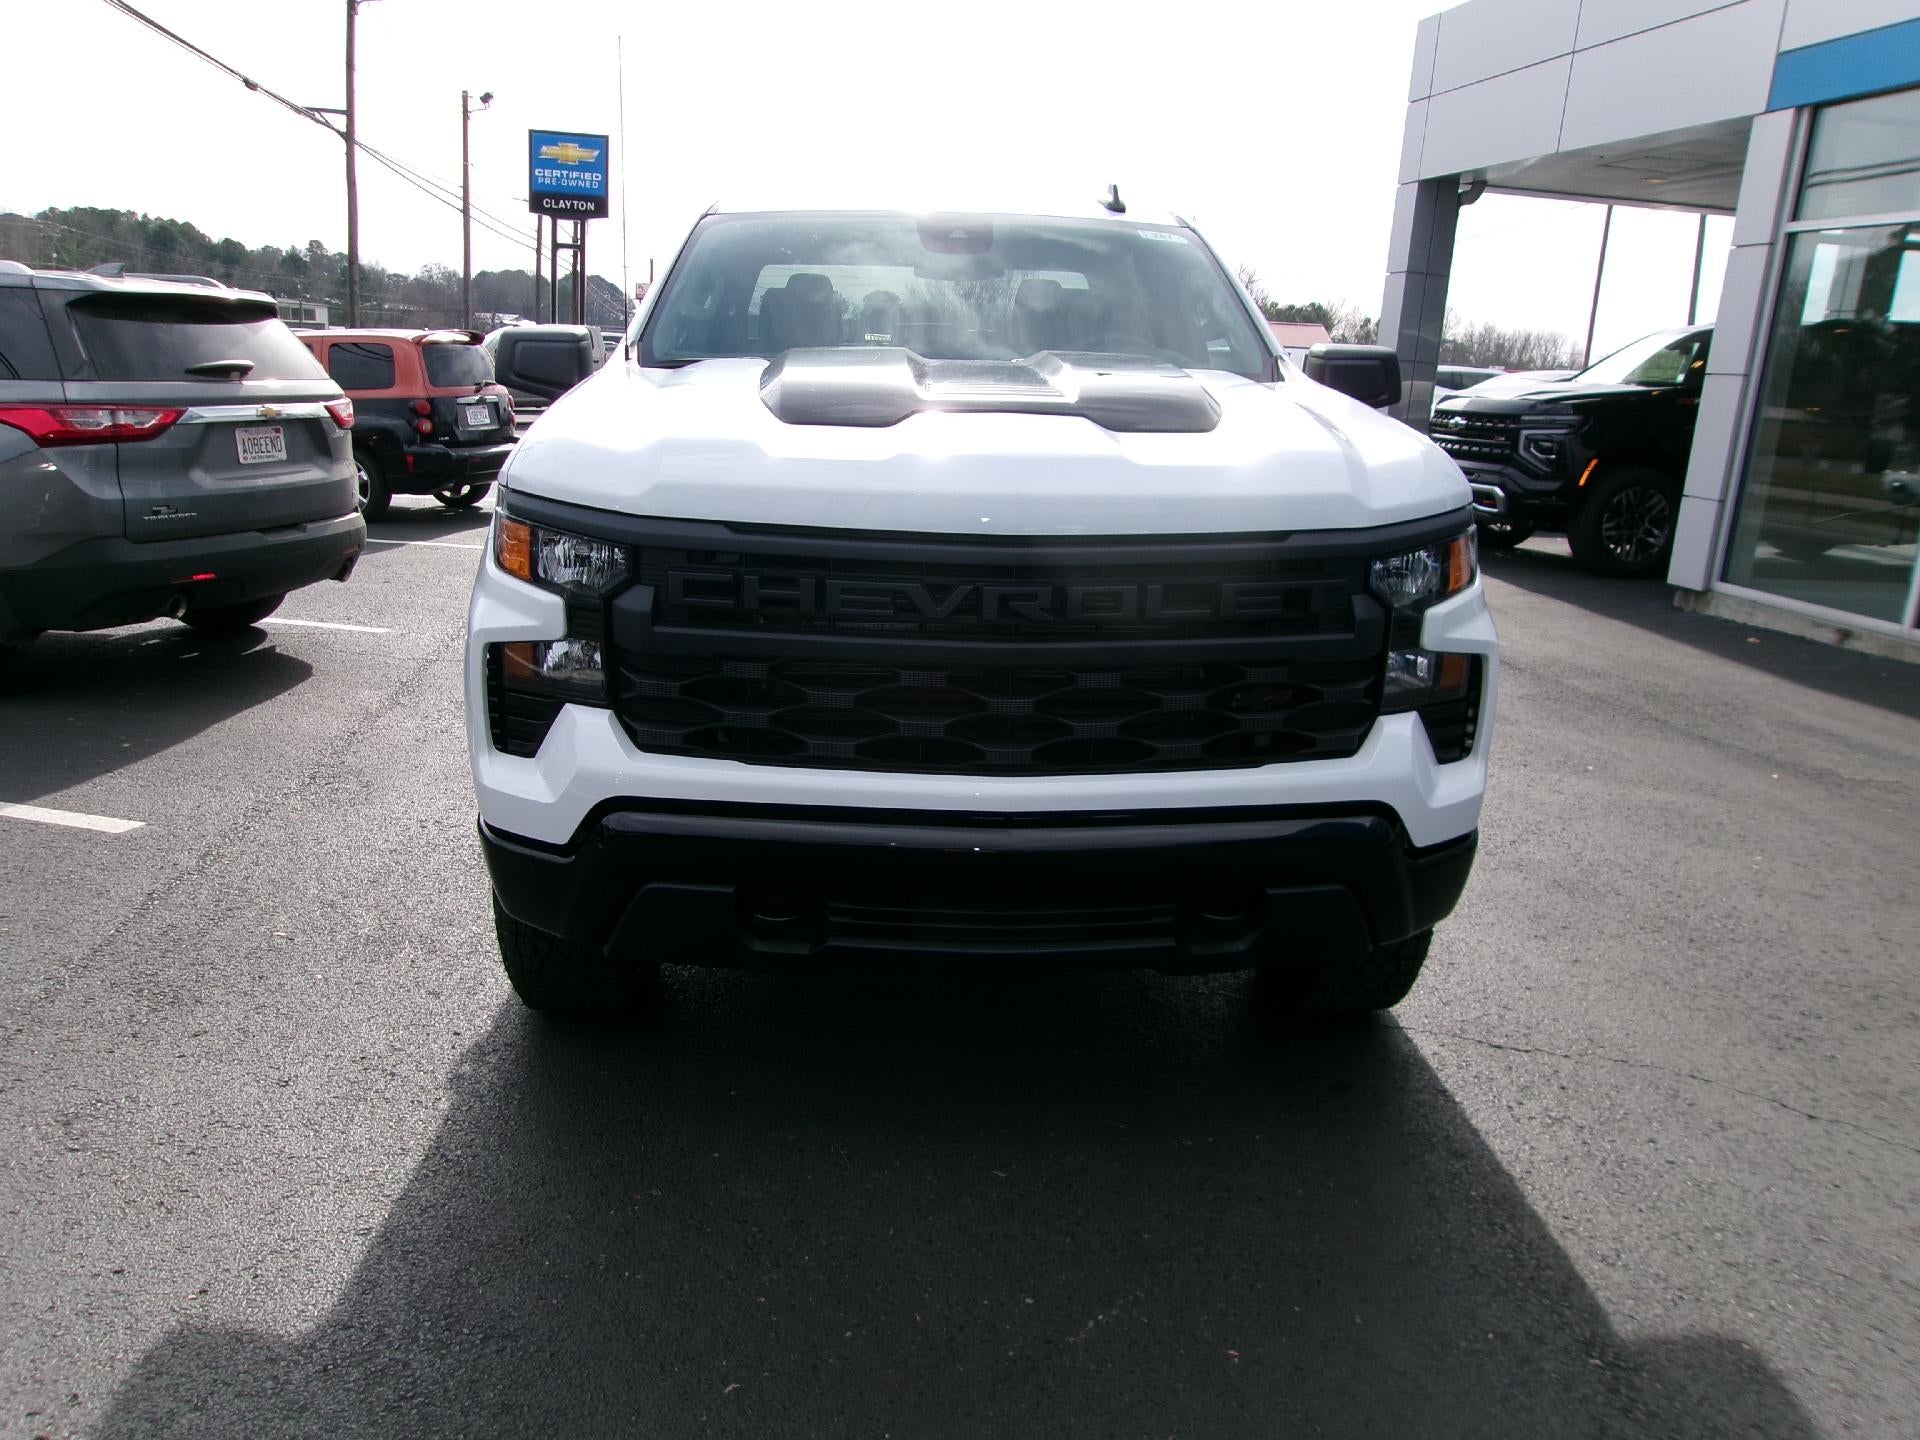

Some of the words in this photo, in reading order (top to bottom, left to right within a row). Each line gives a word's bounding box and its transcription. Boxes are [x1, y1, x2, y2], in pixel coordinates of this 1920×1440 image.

[535, 168, 602, 181] CERTIFIED
[538, 177, 599, 189] PRE-OWNED
[543, 198, 595, 211] CLAYTON
[666, 570, 1345, 621] CHEVROLET
